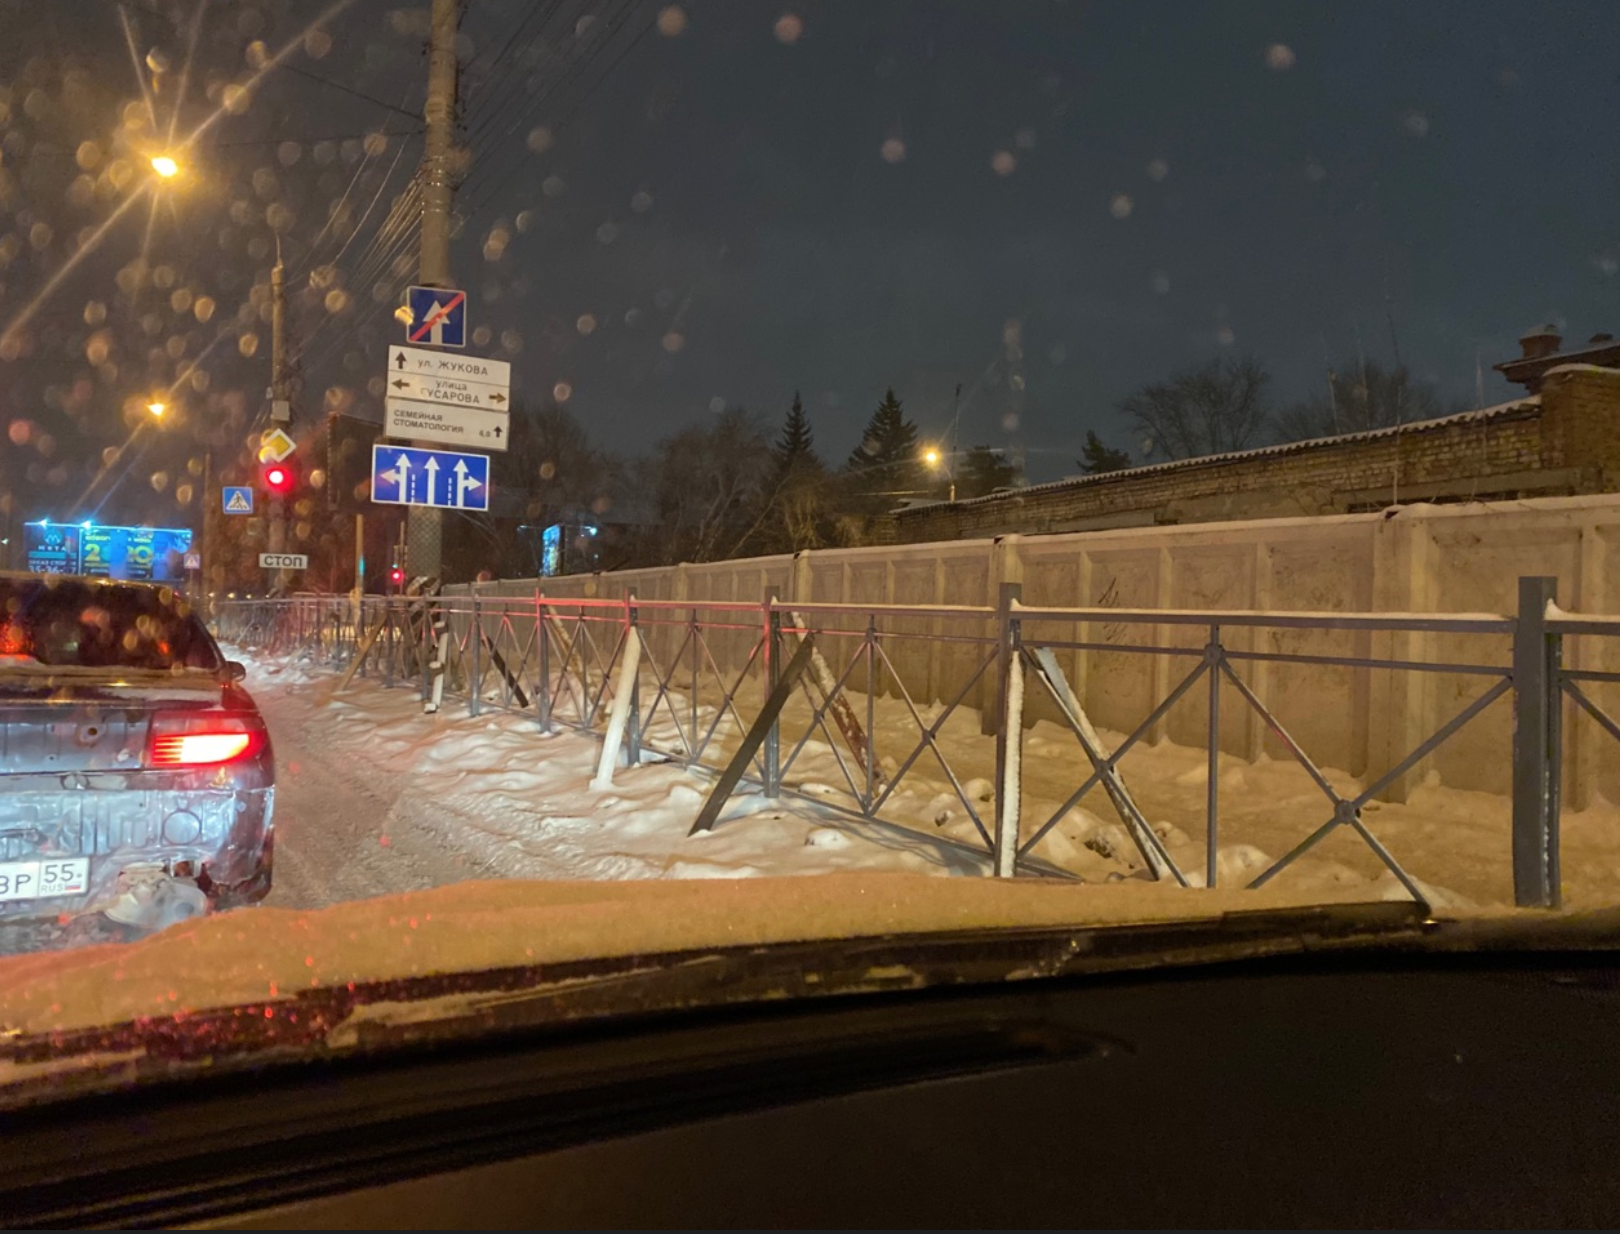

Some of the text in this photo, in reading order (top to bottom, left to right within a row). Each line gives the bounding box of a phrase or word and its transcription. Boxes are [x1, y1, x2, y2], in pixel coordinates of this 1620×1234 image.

[417, 359, 488, 376] ул. ЖУКОВА
[435, 380, 468, 391] улица
[420, 387, 480, 404] ГУСАРОВА
[393, 409, 443, 422] СЕМЕЙНАЯ
[393, 418, 464, 433] СТОМАТОЛОГИЯ
[264, 555, 303, 567] СТОП
[44, 863, 75, 883] 55
[41, 883, 63, 893] RUS
